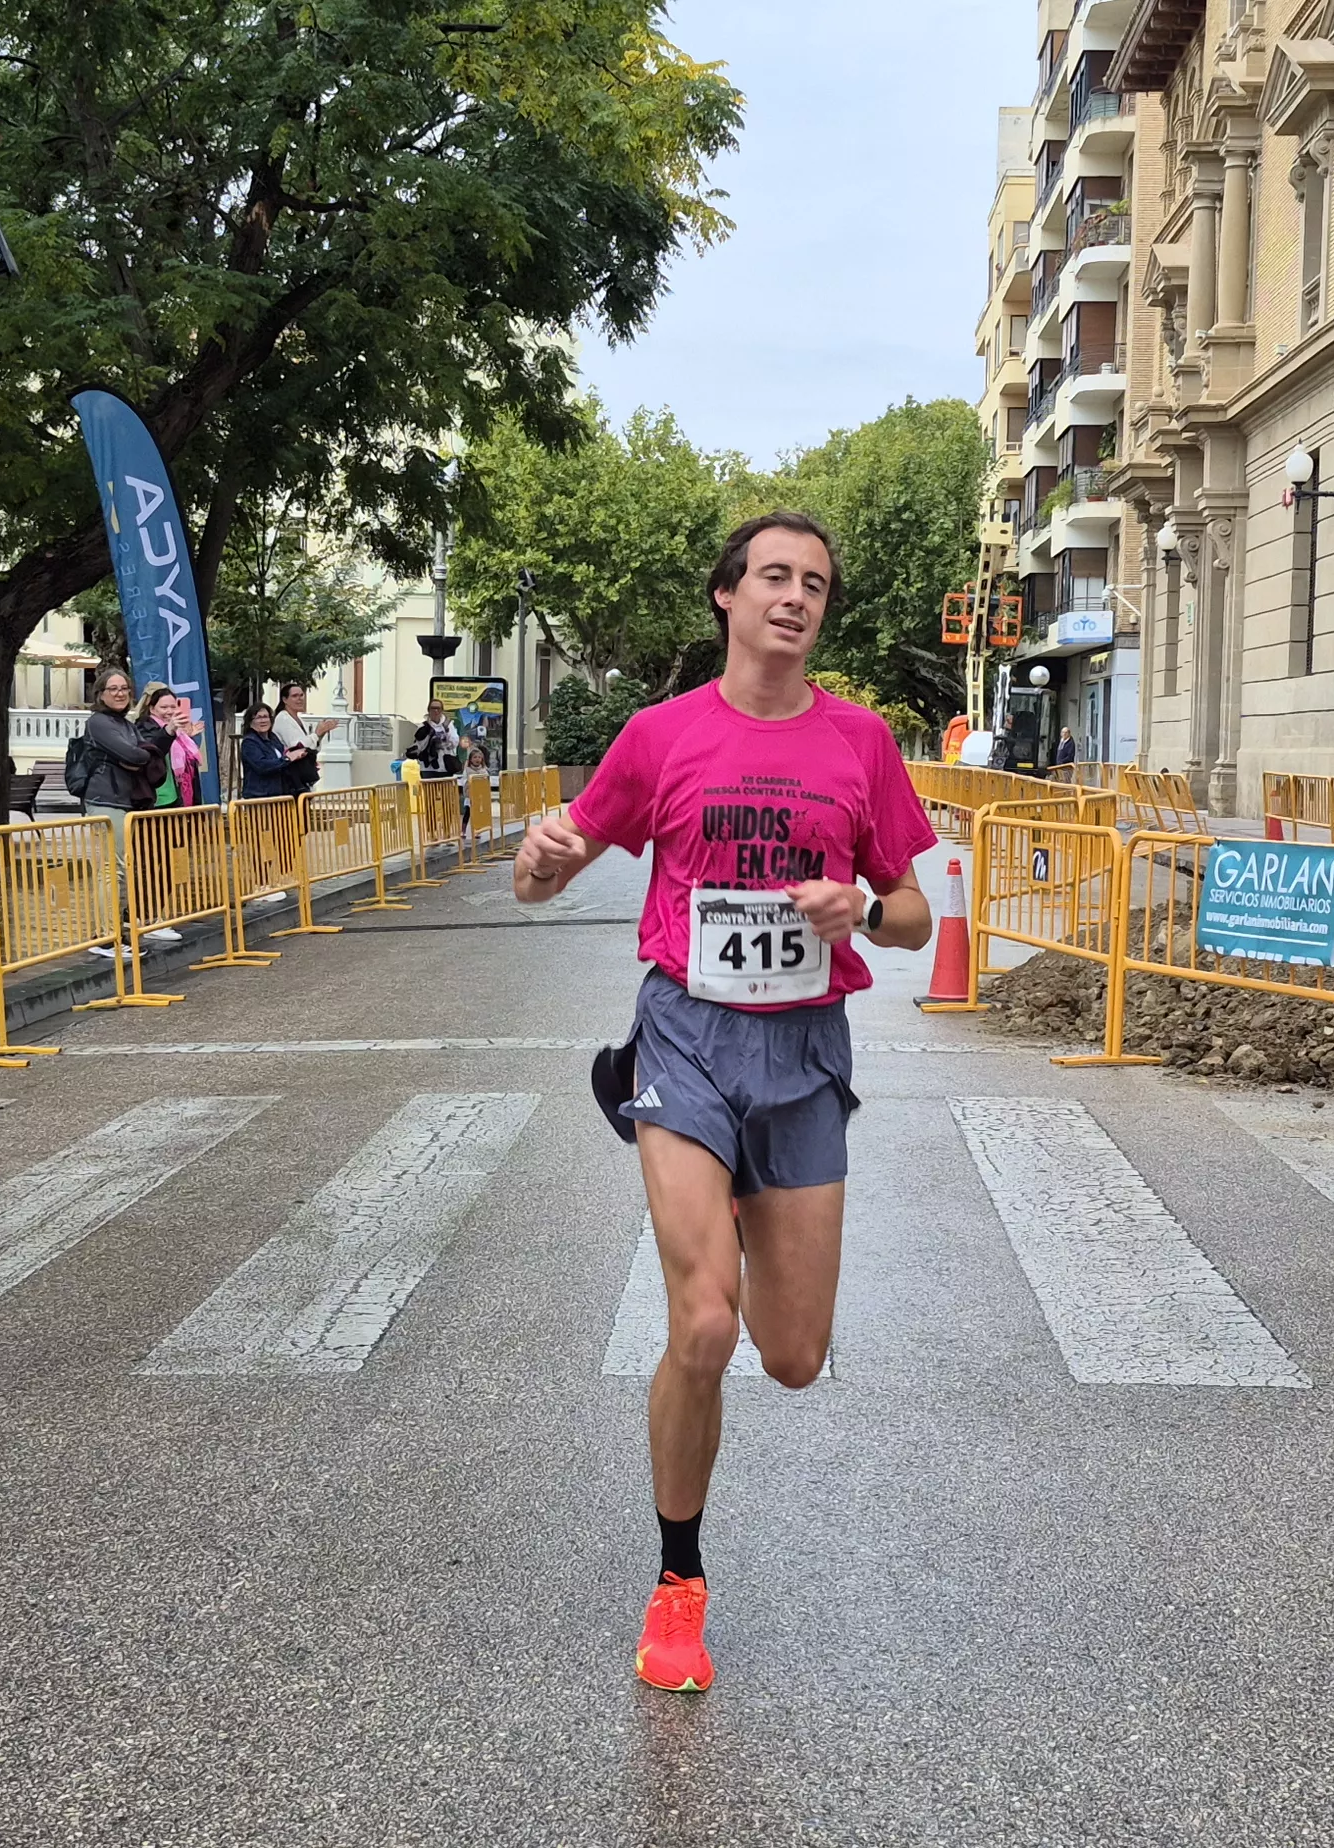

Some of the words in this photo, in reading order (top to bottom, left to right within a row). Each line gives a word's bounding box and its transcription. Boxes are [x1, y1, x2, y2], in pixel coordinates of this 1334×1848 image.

[743, 786, 784, 797] CONTRA
[786, 788, 797, 799] EL
[703, 804, 791, 843] UNIDOS
[736, 844, 766, 879] EN
[771, 845, 825, 881] CADA
[1209, 888, 1259, 908] SERVICIOS
[1260, 894, 1332, 914] INMOBILIARIOS
[707, 911, 754, 925] CONTRA
[756, 913, 771, 925] EL
[719, 929, 805, 971] 415
